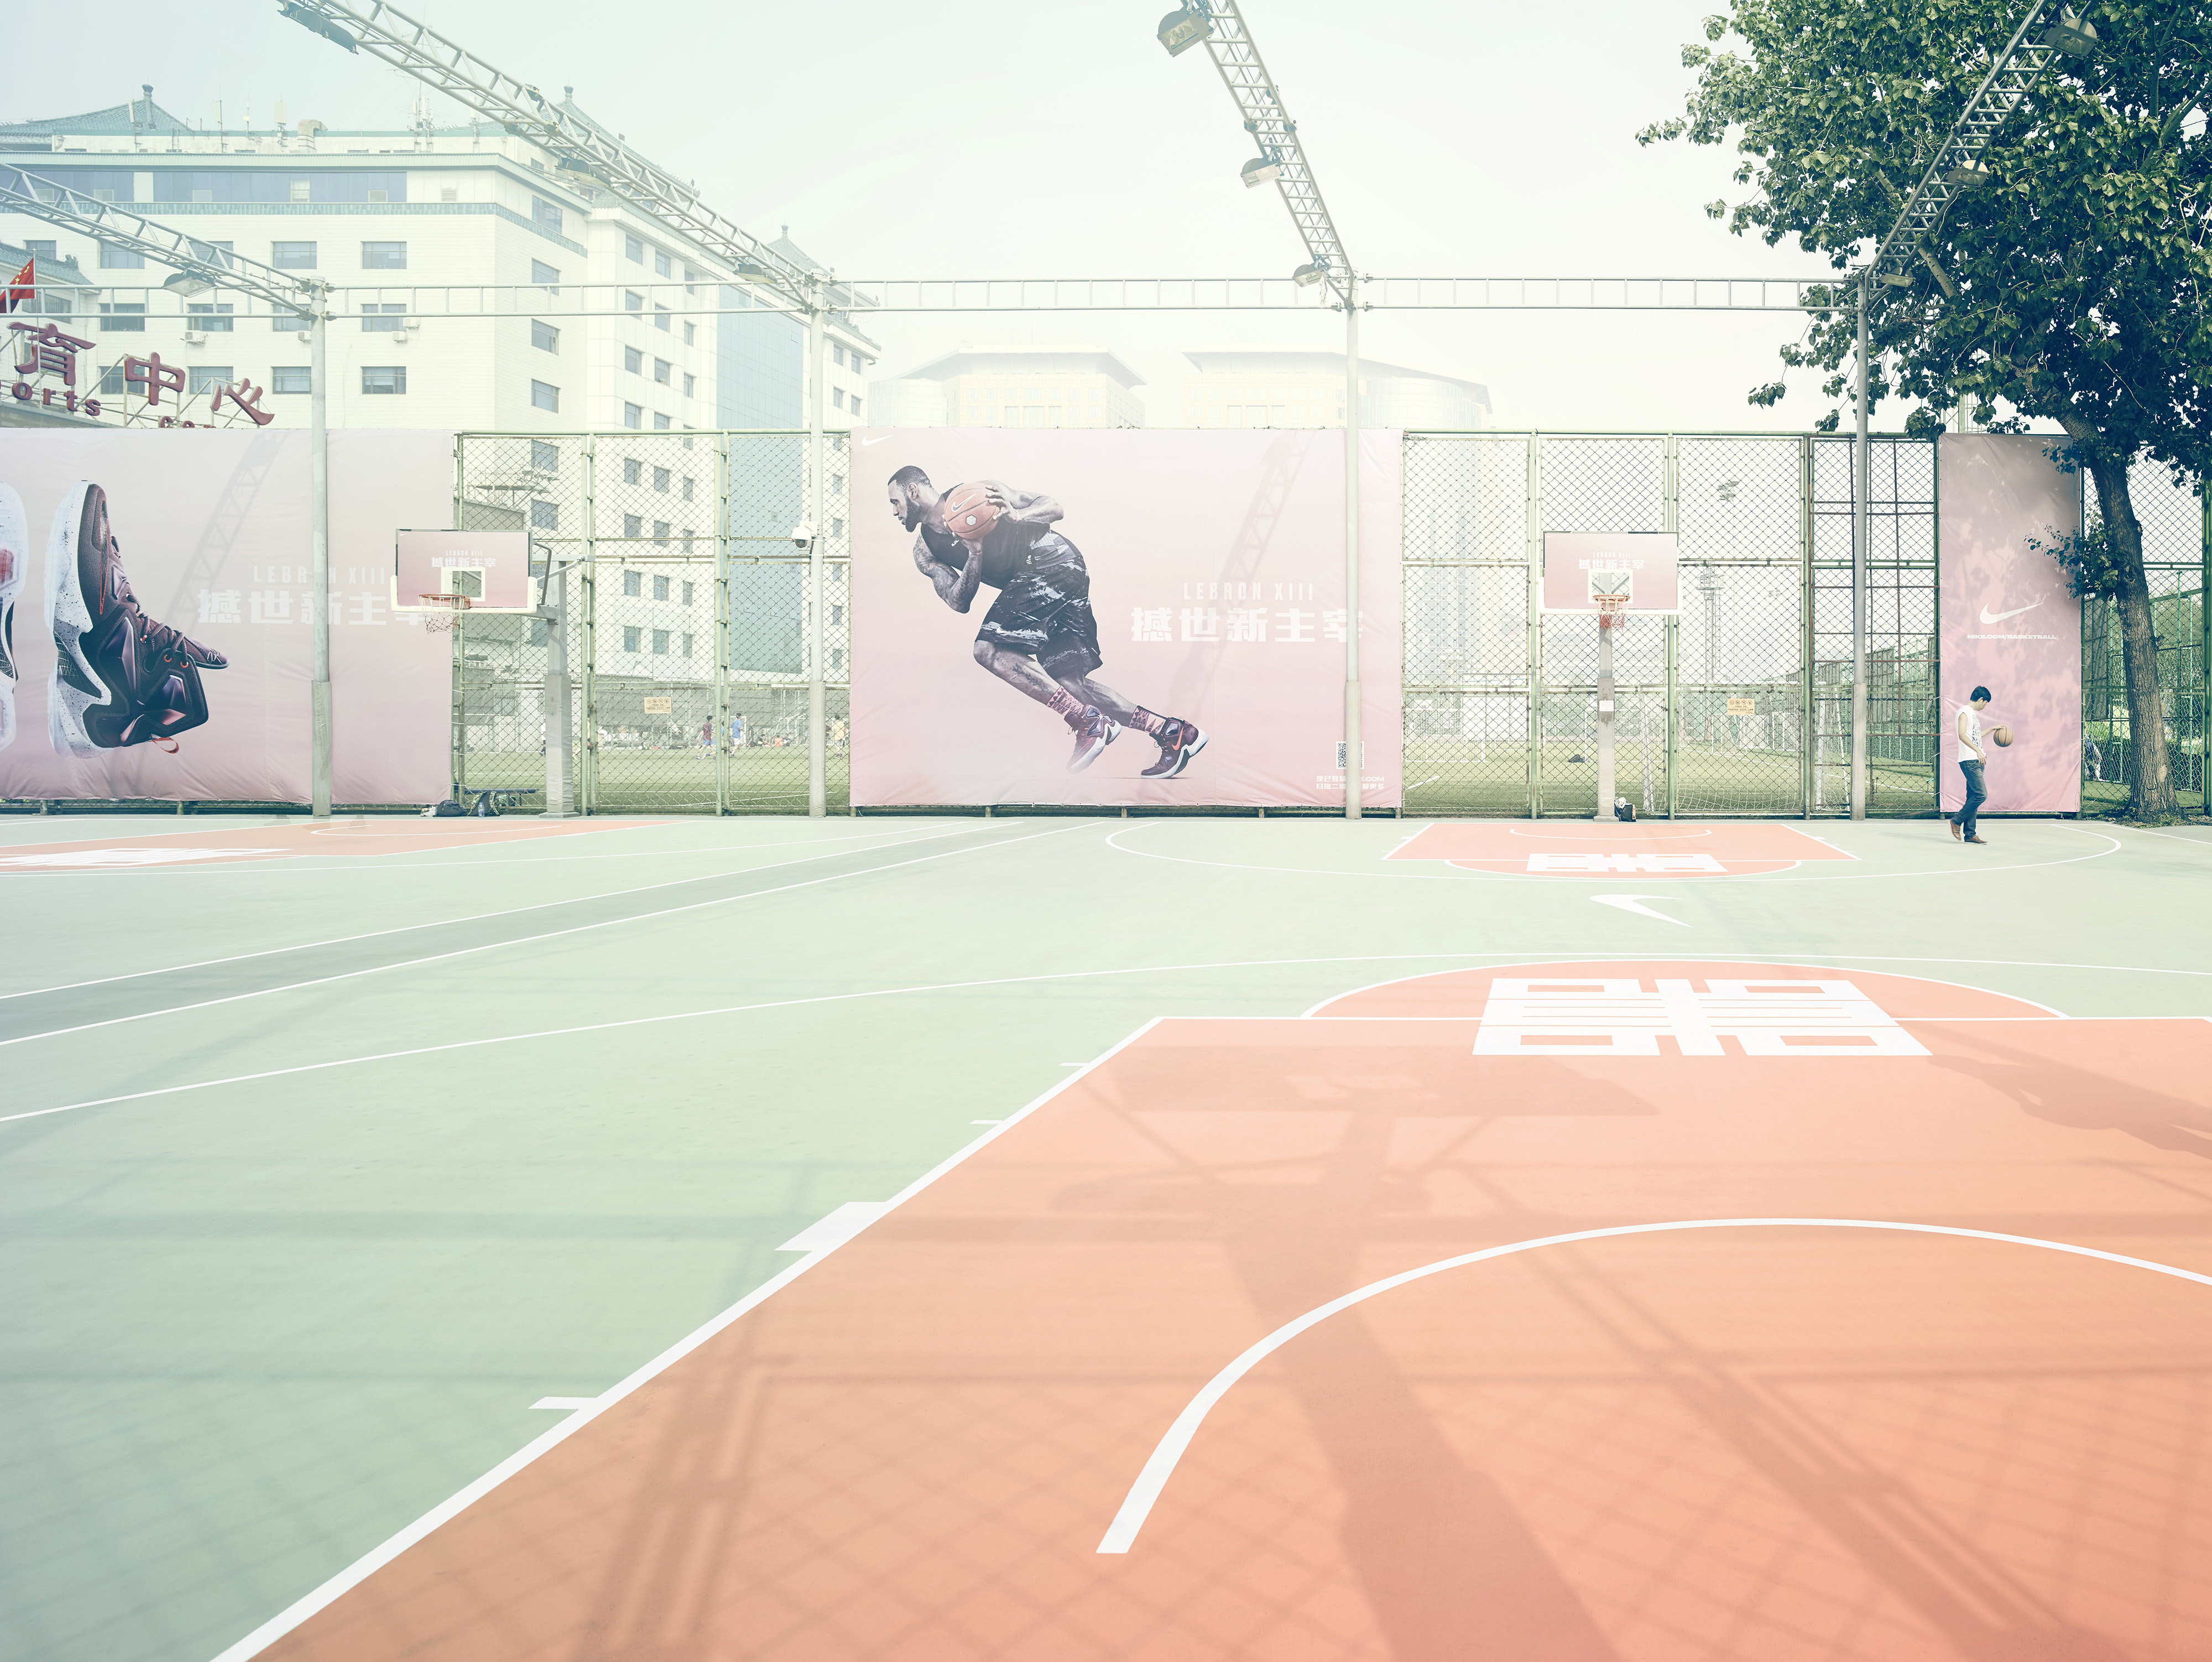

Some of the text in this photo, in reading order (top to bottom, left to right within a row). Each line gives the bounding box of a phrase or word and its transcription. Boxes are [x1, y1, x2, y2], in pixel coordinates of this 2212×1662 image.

[7, 321, 275, 425] 育中心
[0, 380, 101, 416] orts
[253, 566, 385, 584] LEBRN XIII
[1183, 582, 1313, 601] LEBRON XIII
[1131, 607, 1363, 643] 撼世新主宰
